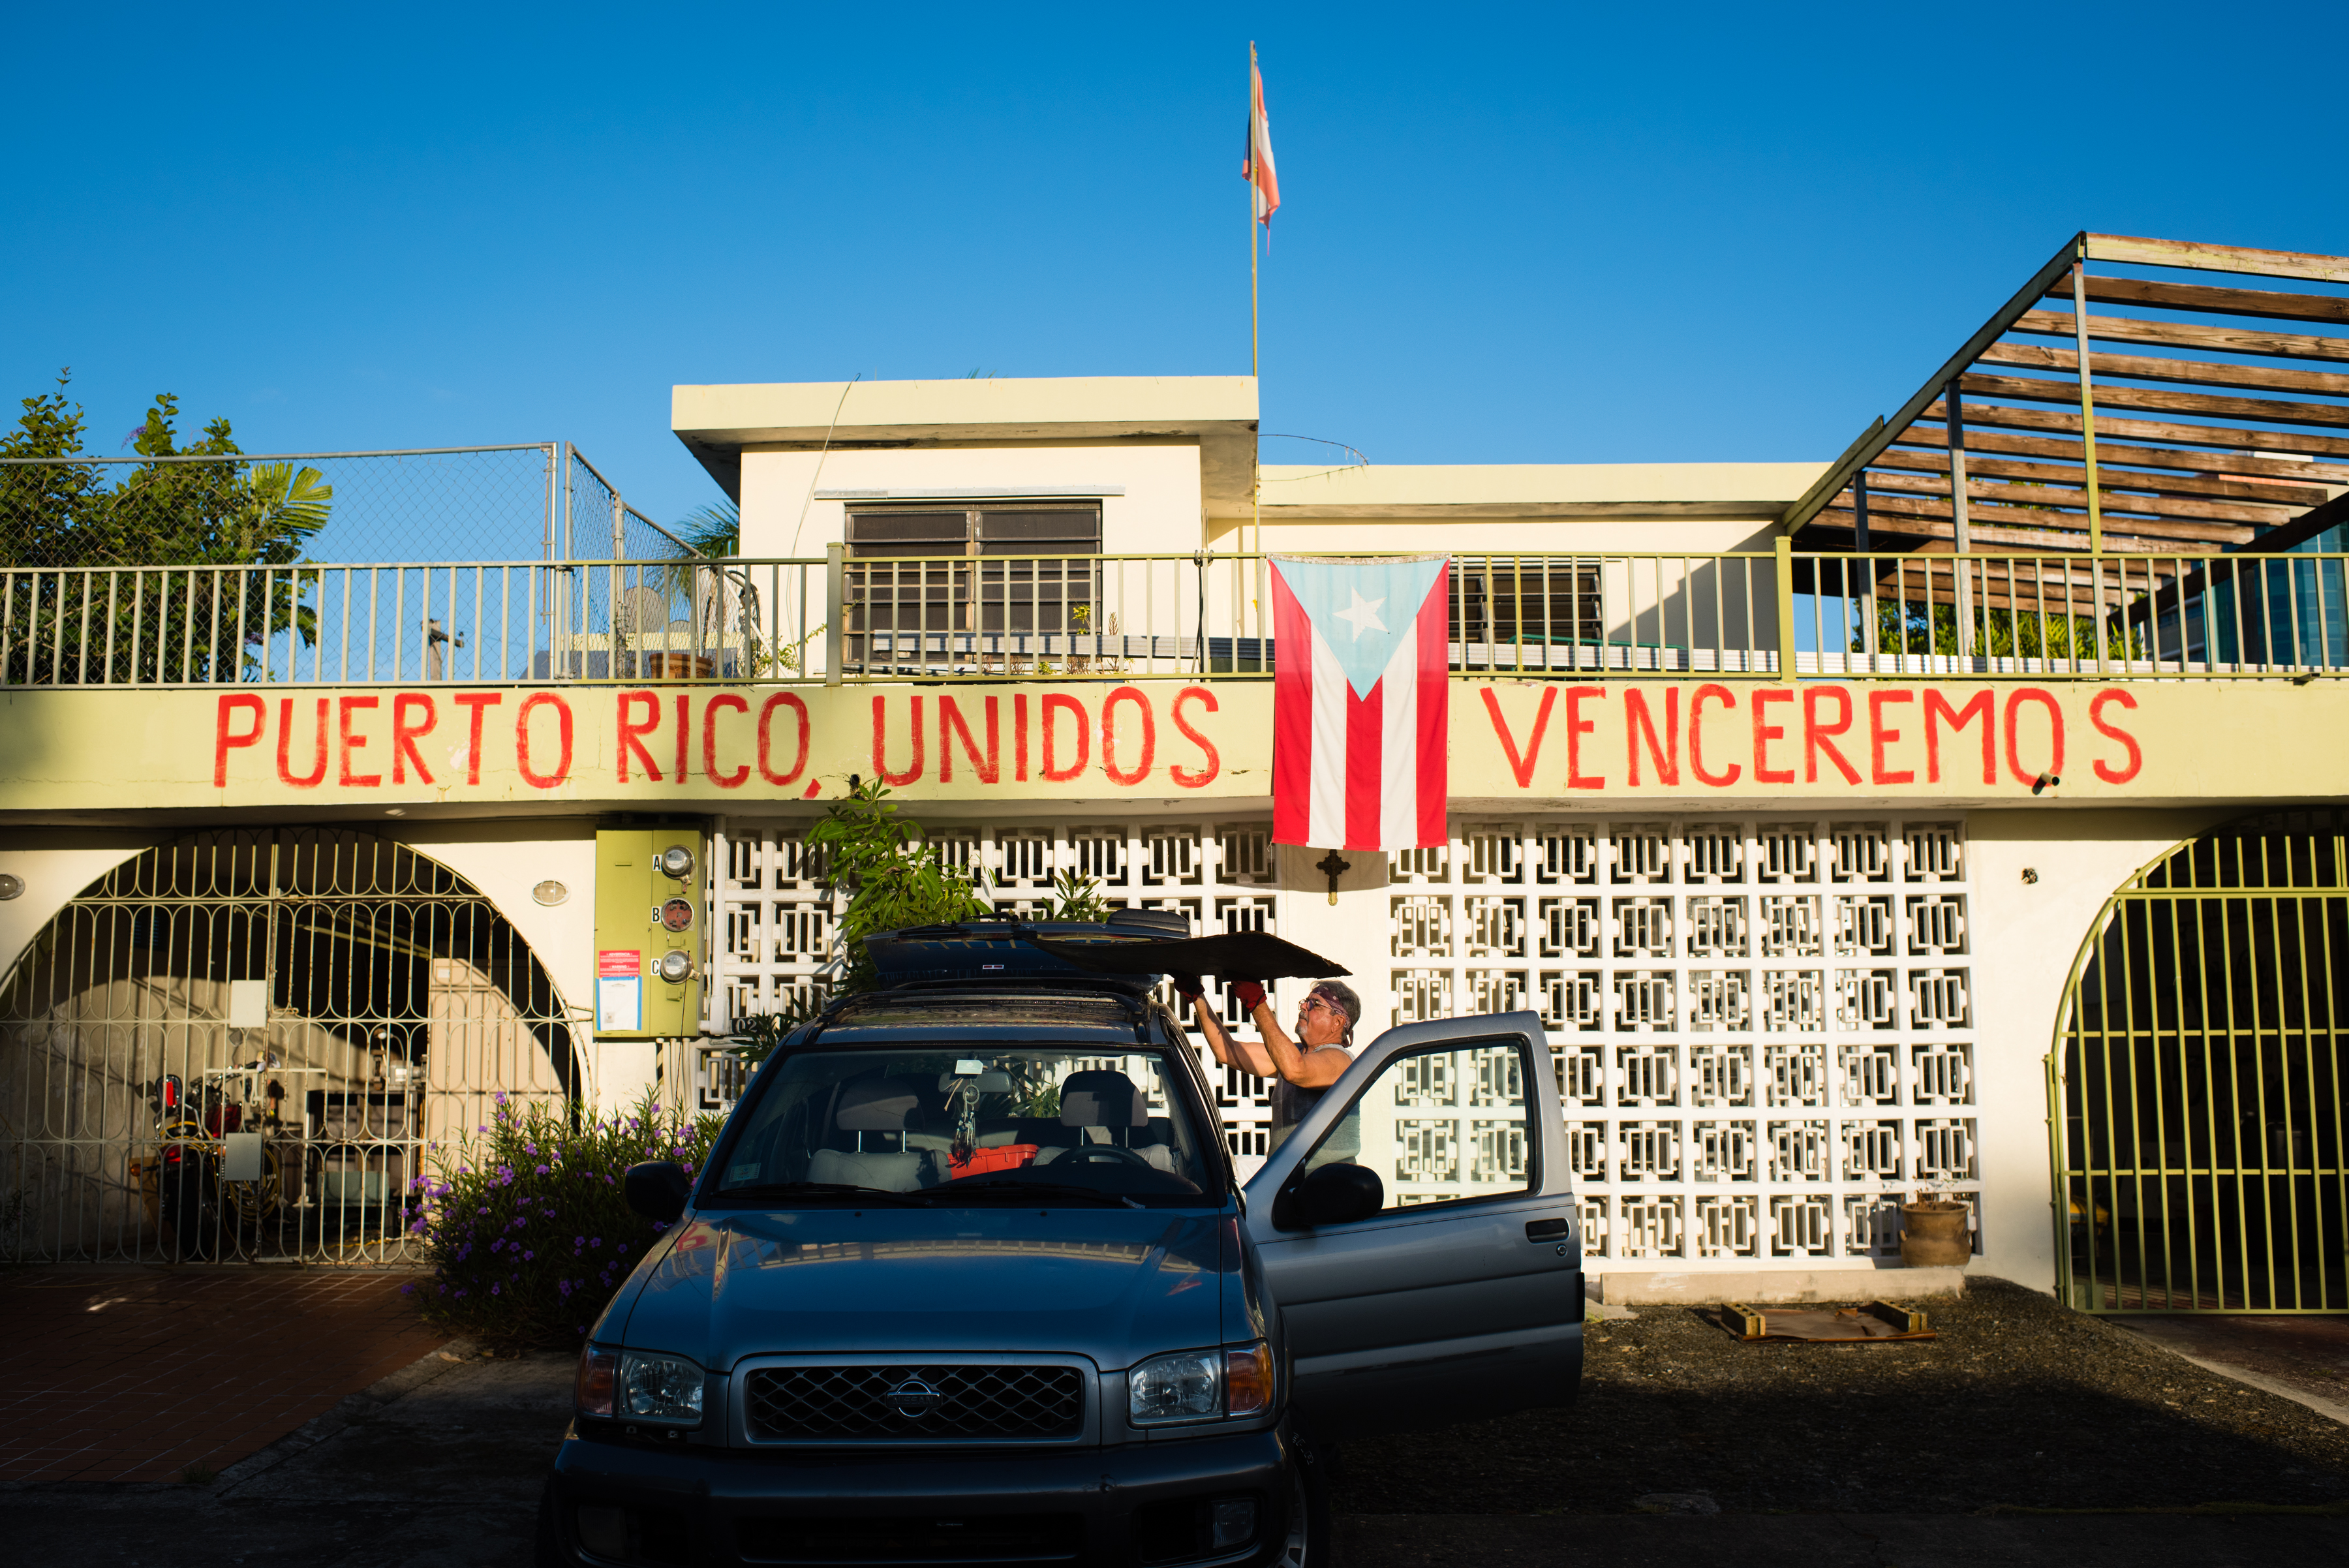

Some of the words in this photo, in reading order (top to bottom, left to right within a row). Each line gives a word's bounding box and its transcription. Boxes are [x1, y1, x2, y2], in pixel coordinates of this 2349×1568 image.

[214, 692, 573, 789] PUERTO
[617, 690, 821, 799] RICO,
[872, 686, 1220, 788] UNIDOS
[1481, 684, 2142, 789] VENCEREMOS
[653, 855, 660, 870] A
[652, 908, 660, 921] B
[652, 960, 659, 974] C
[729, 1019, 769, 1034] 102
[893, 1395, 933, 1404] NISSAN
